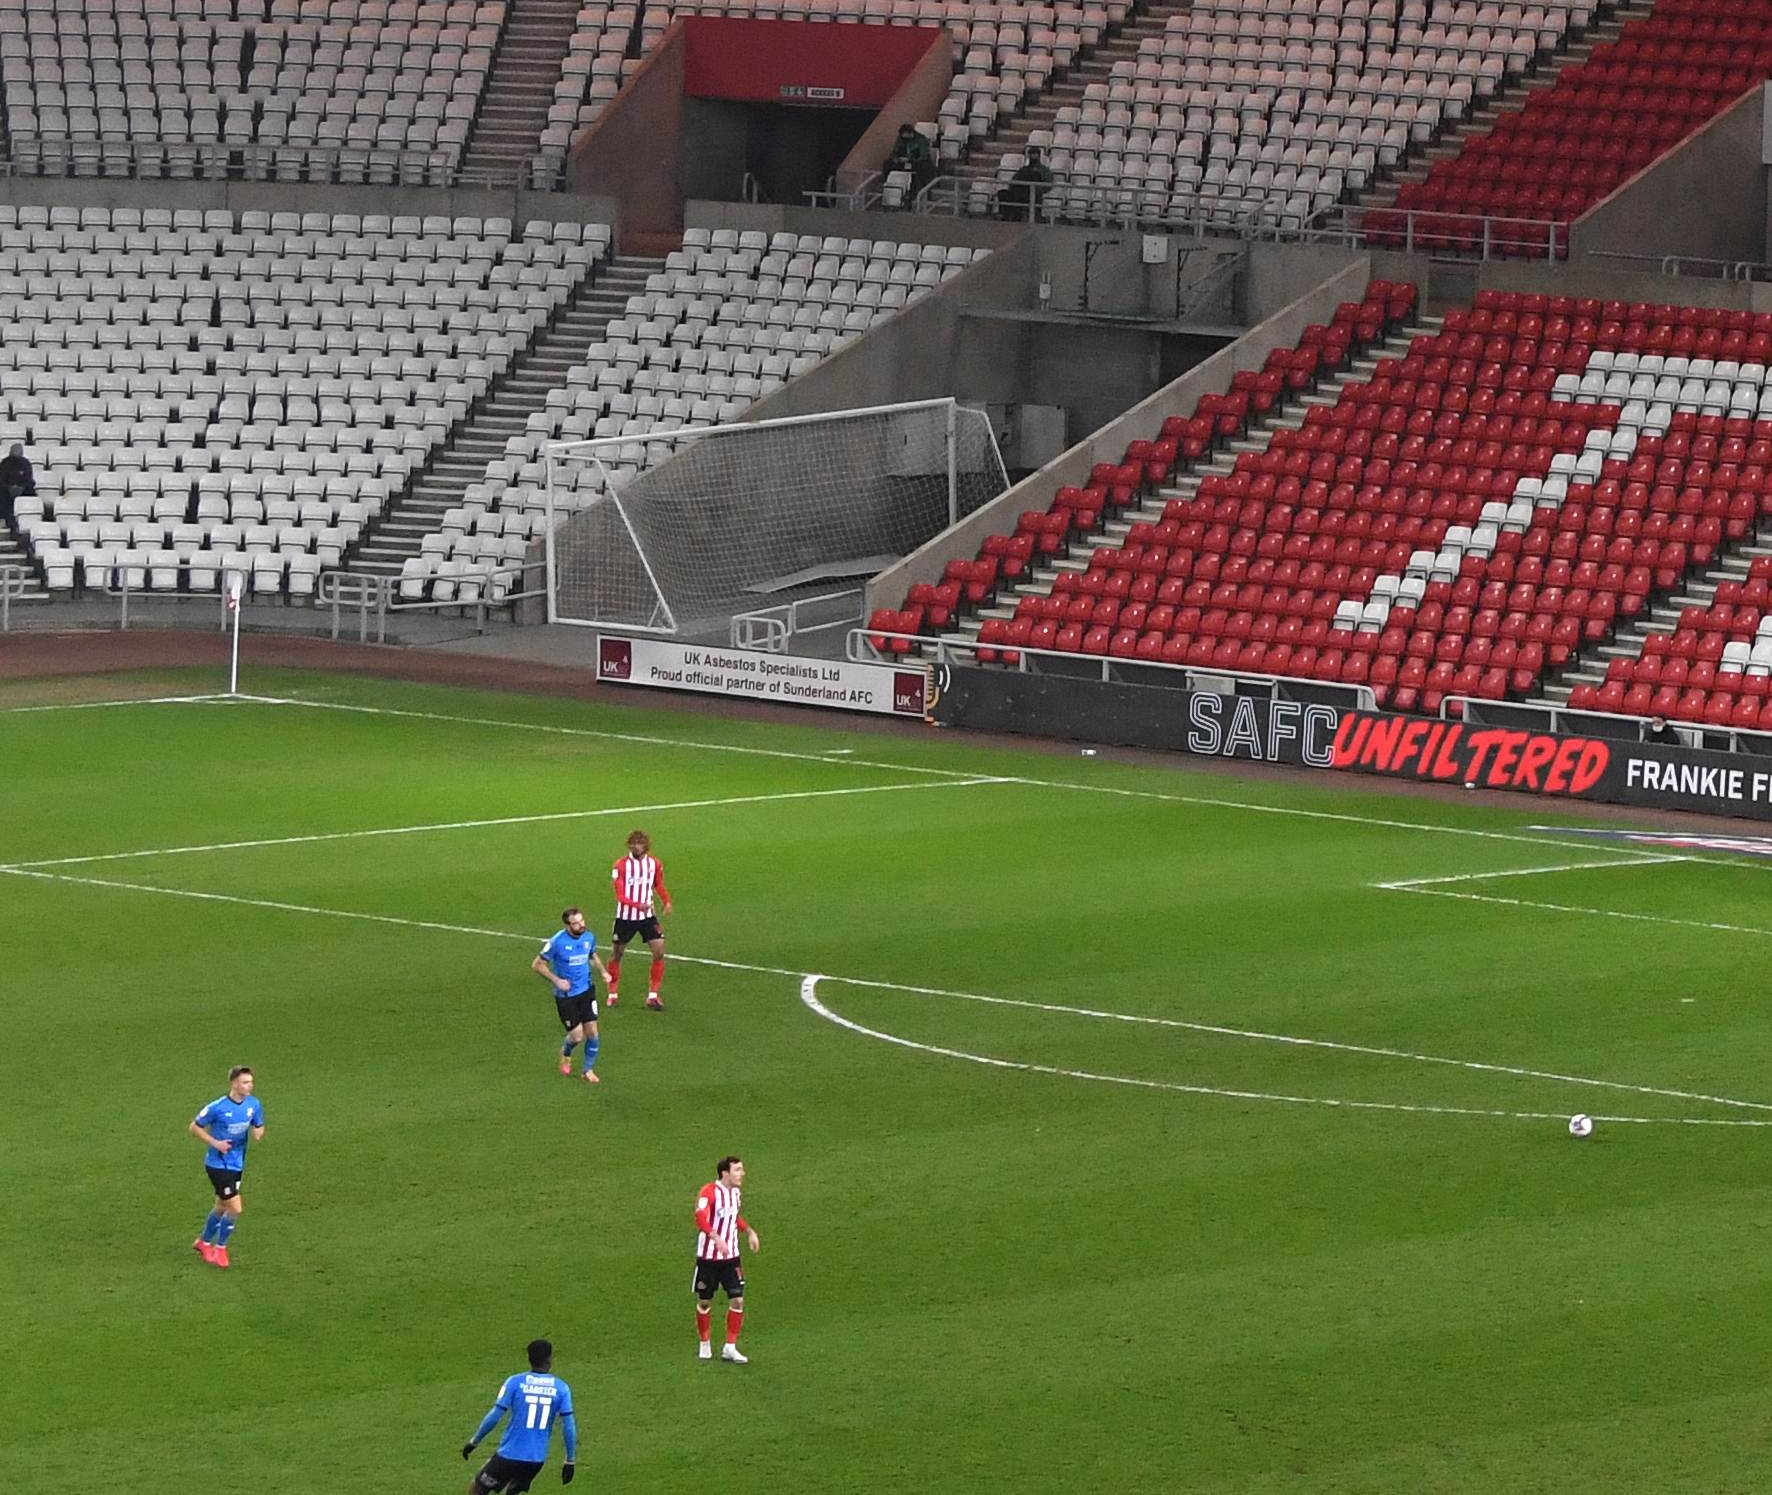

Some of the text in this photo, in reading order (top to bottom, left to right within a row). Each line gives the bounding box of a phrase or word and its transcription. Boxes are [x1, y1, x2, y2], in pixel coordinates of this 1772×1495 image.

[603, 661, 619, 673] UK
[684, 650, 840, 682] UK Asbestos Specialists Ltd
[651, 665, 873, 704] Proud official partner of Sunderland AFC
[896, 694, 911, 706] UK
[1187, 691, 1610, 794] SAFC UNFILTERED
[1626, 758, 1744, 802] FRANKIE
[524, 1395, 553, 1430] 11
